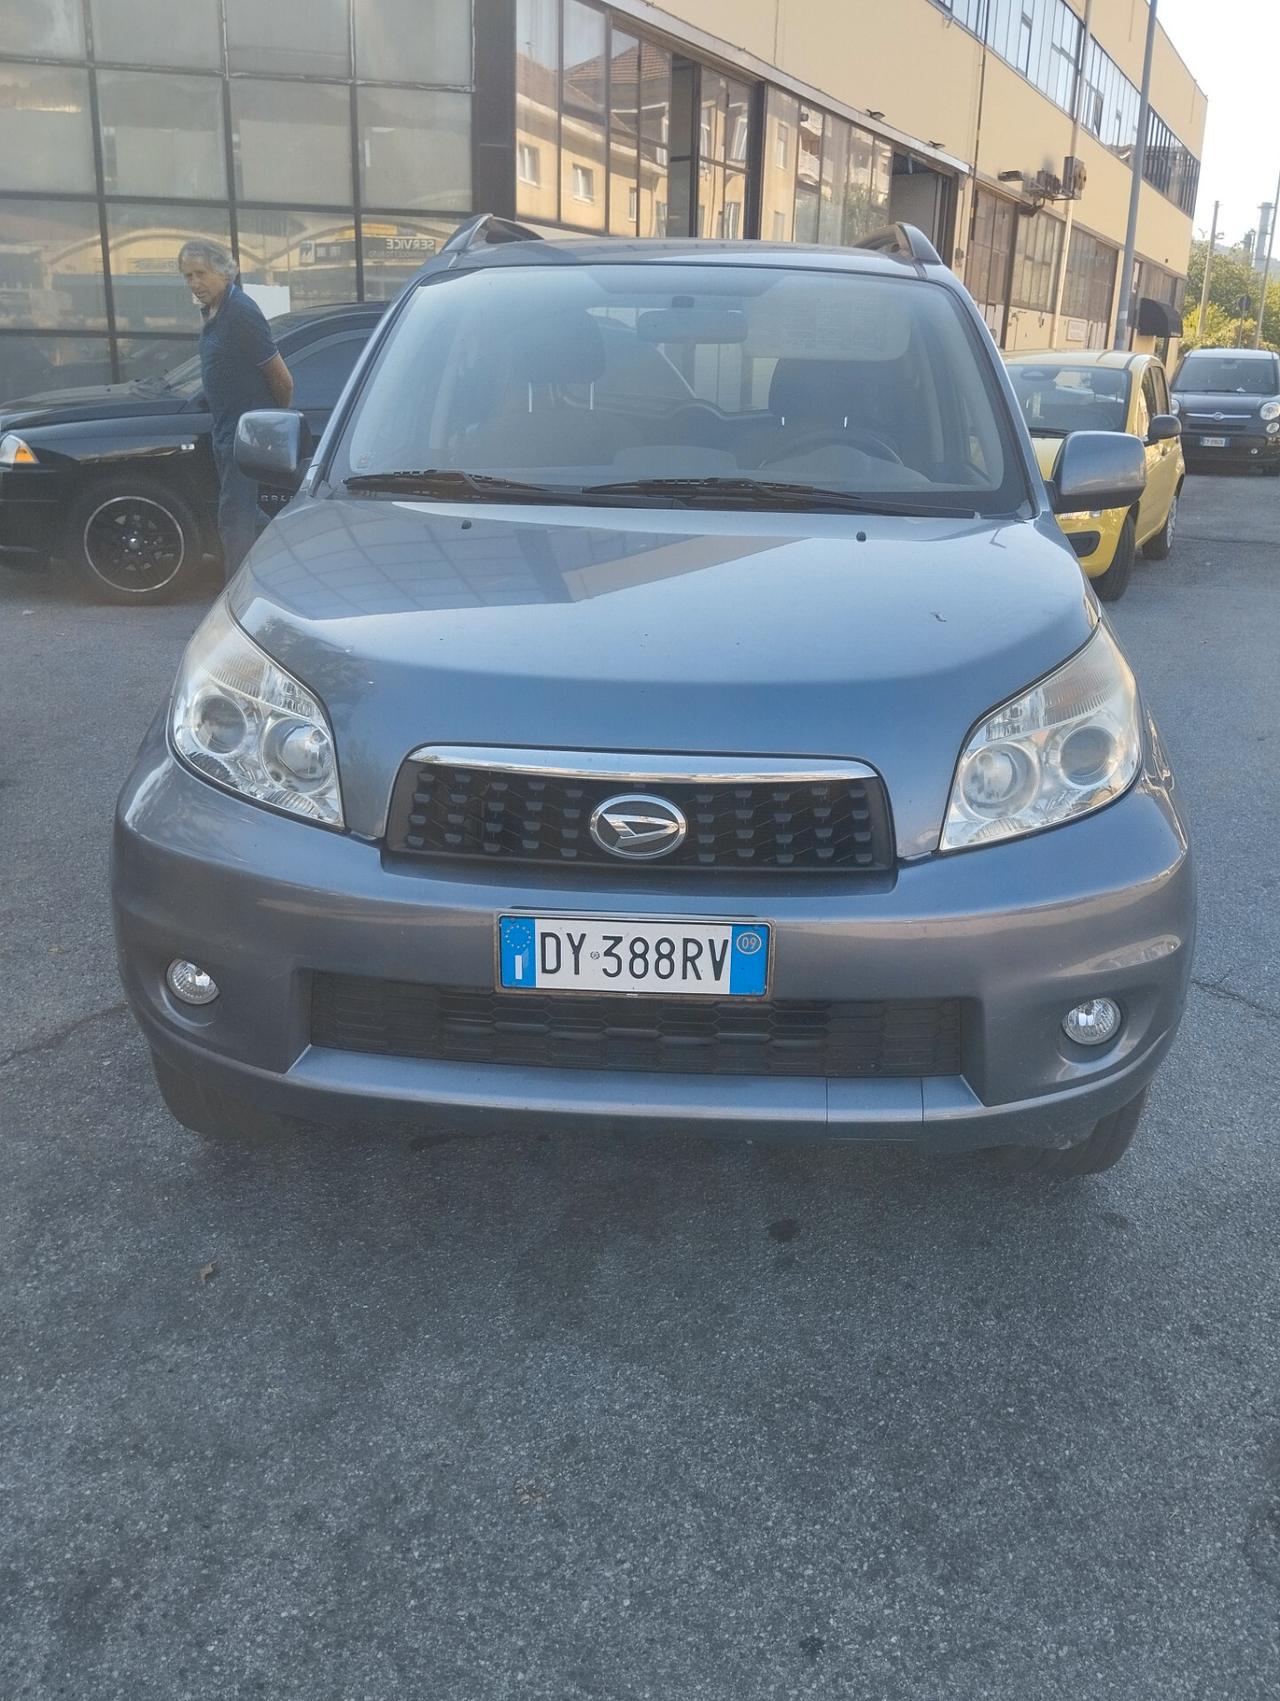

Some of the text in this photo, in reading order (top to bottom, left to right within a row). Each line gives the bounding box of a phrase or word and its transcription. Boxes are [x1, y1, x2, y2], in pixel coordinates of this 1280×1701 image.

[540, 932, 587, 976] DY
[601, 935, 729, 981] 388RV
[741, 934, 758, 949] 09
